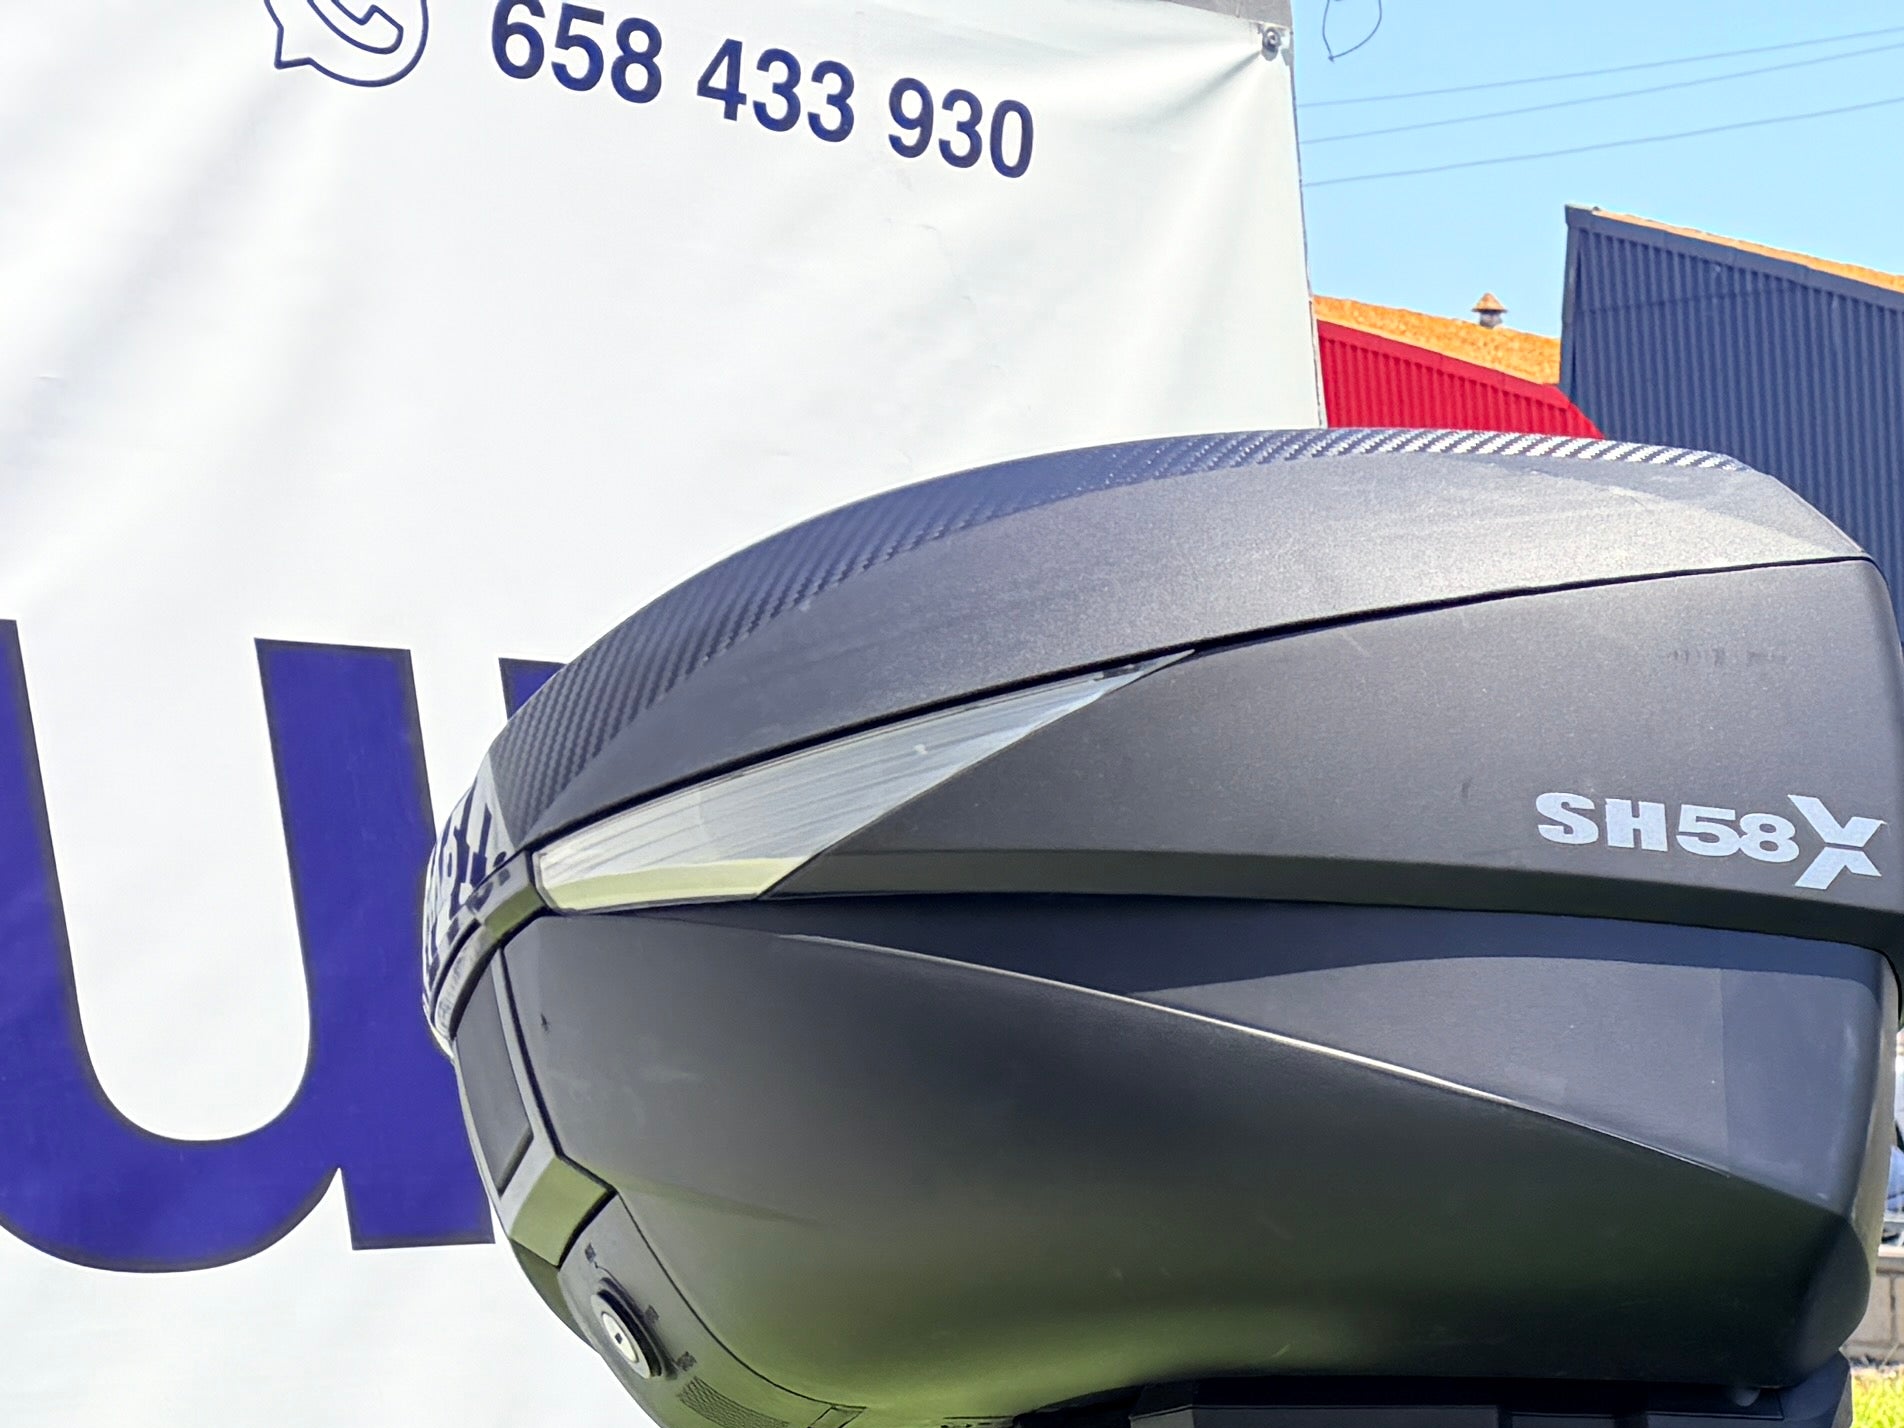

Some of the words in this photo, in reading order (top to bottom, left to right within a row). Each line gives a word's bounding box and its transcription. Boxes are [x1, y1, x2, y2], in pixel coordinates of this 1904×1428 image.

[491, 0, 662, 104] 658
[696, 38, 855, 143] 433
[888, 77, 1035, 179] 930
[1535, 791, 1888, 891] SH58X
